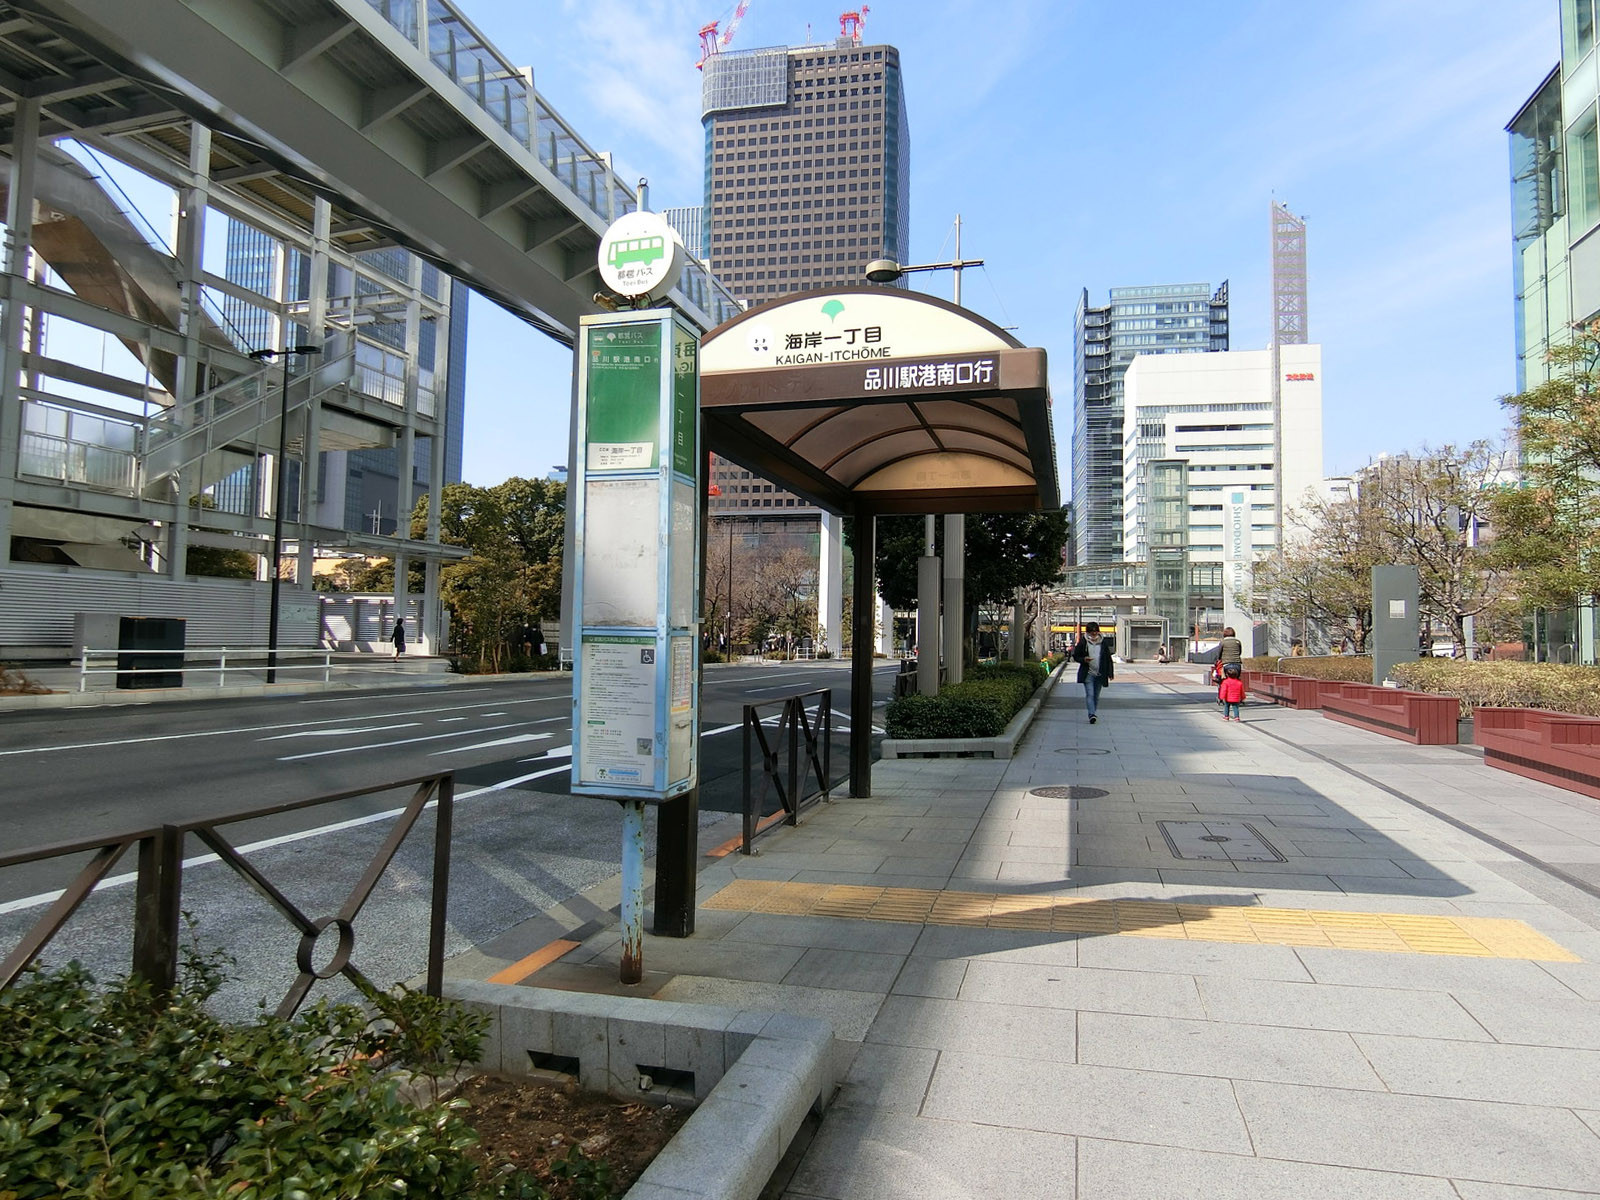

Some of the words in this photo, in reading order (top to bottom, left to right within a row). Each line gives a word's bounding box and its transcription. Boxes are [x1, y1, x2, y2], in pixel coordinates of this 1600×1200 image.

[785, 326, 882, 350] 海岸一丁目
[864, 360, 994, 391] 品川駅港南口行
[1233, 506, 1242, 559] SHIODOME
[1233, 563, 1242, 609] BUILDG
